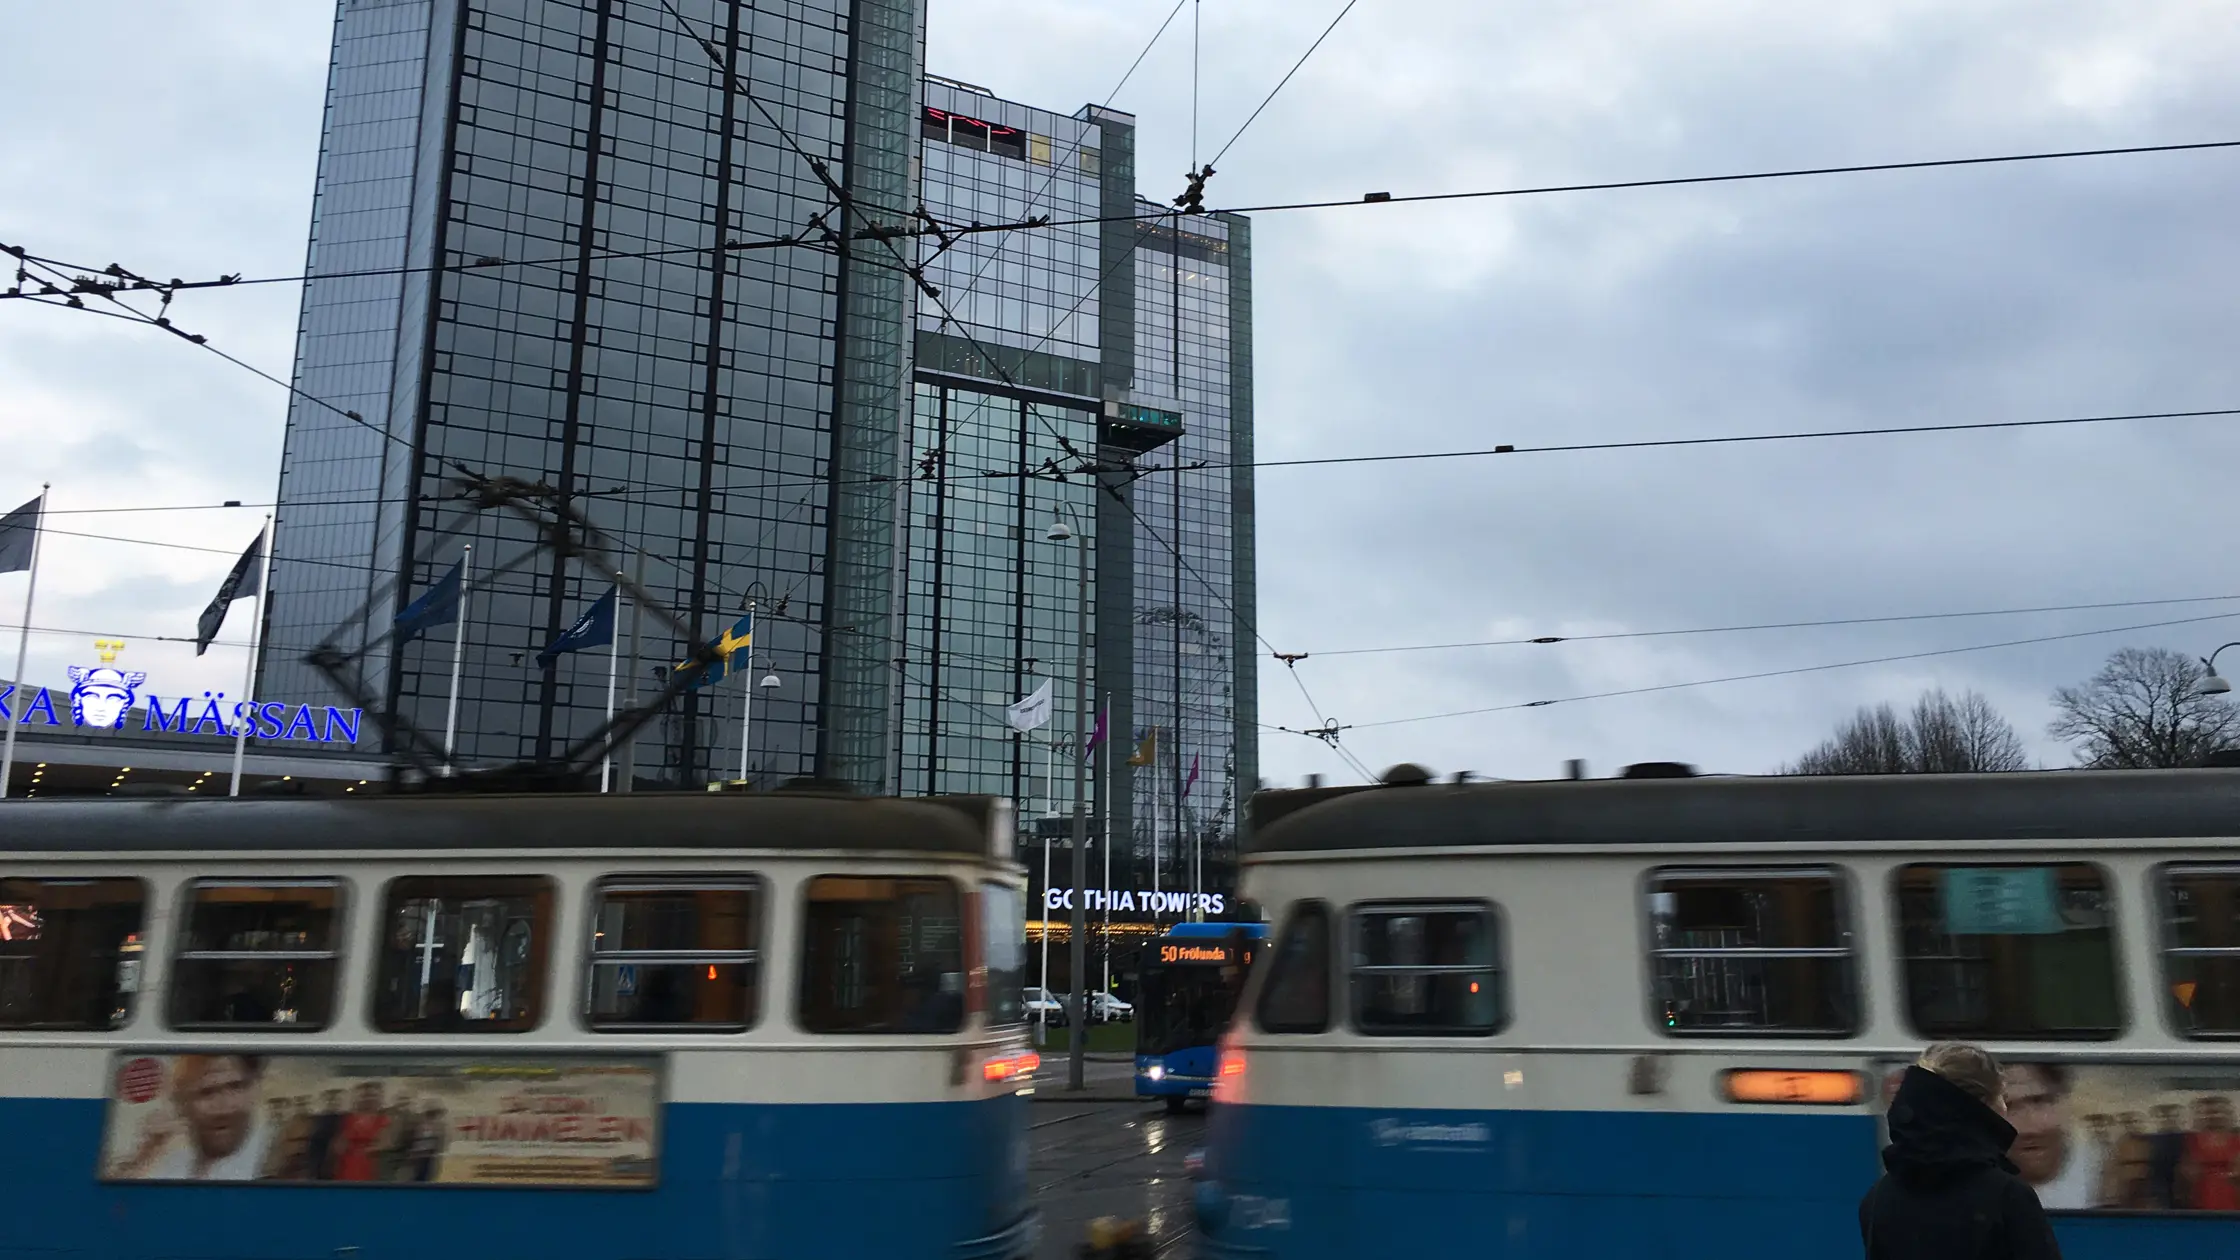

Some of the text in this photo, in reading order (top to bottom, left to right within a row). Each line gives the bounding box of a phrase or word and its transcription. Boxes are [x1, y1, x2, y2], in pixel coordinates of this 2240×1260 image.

[142, 691, 363, 744] MÄSSAN
[1161, 945, 1177, 962] 50
[1179, 946, 1225, 960] Frölunda
